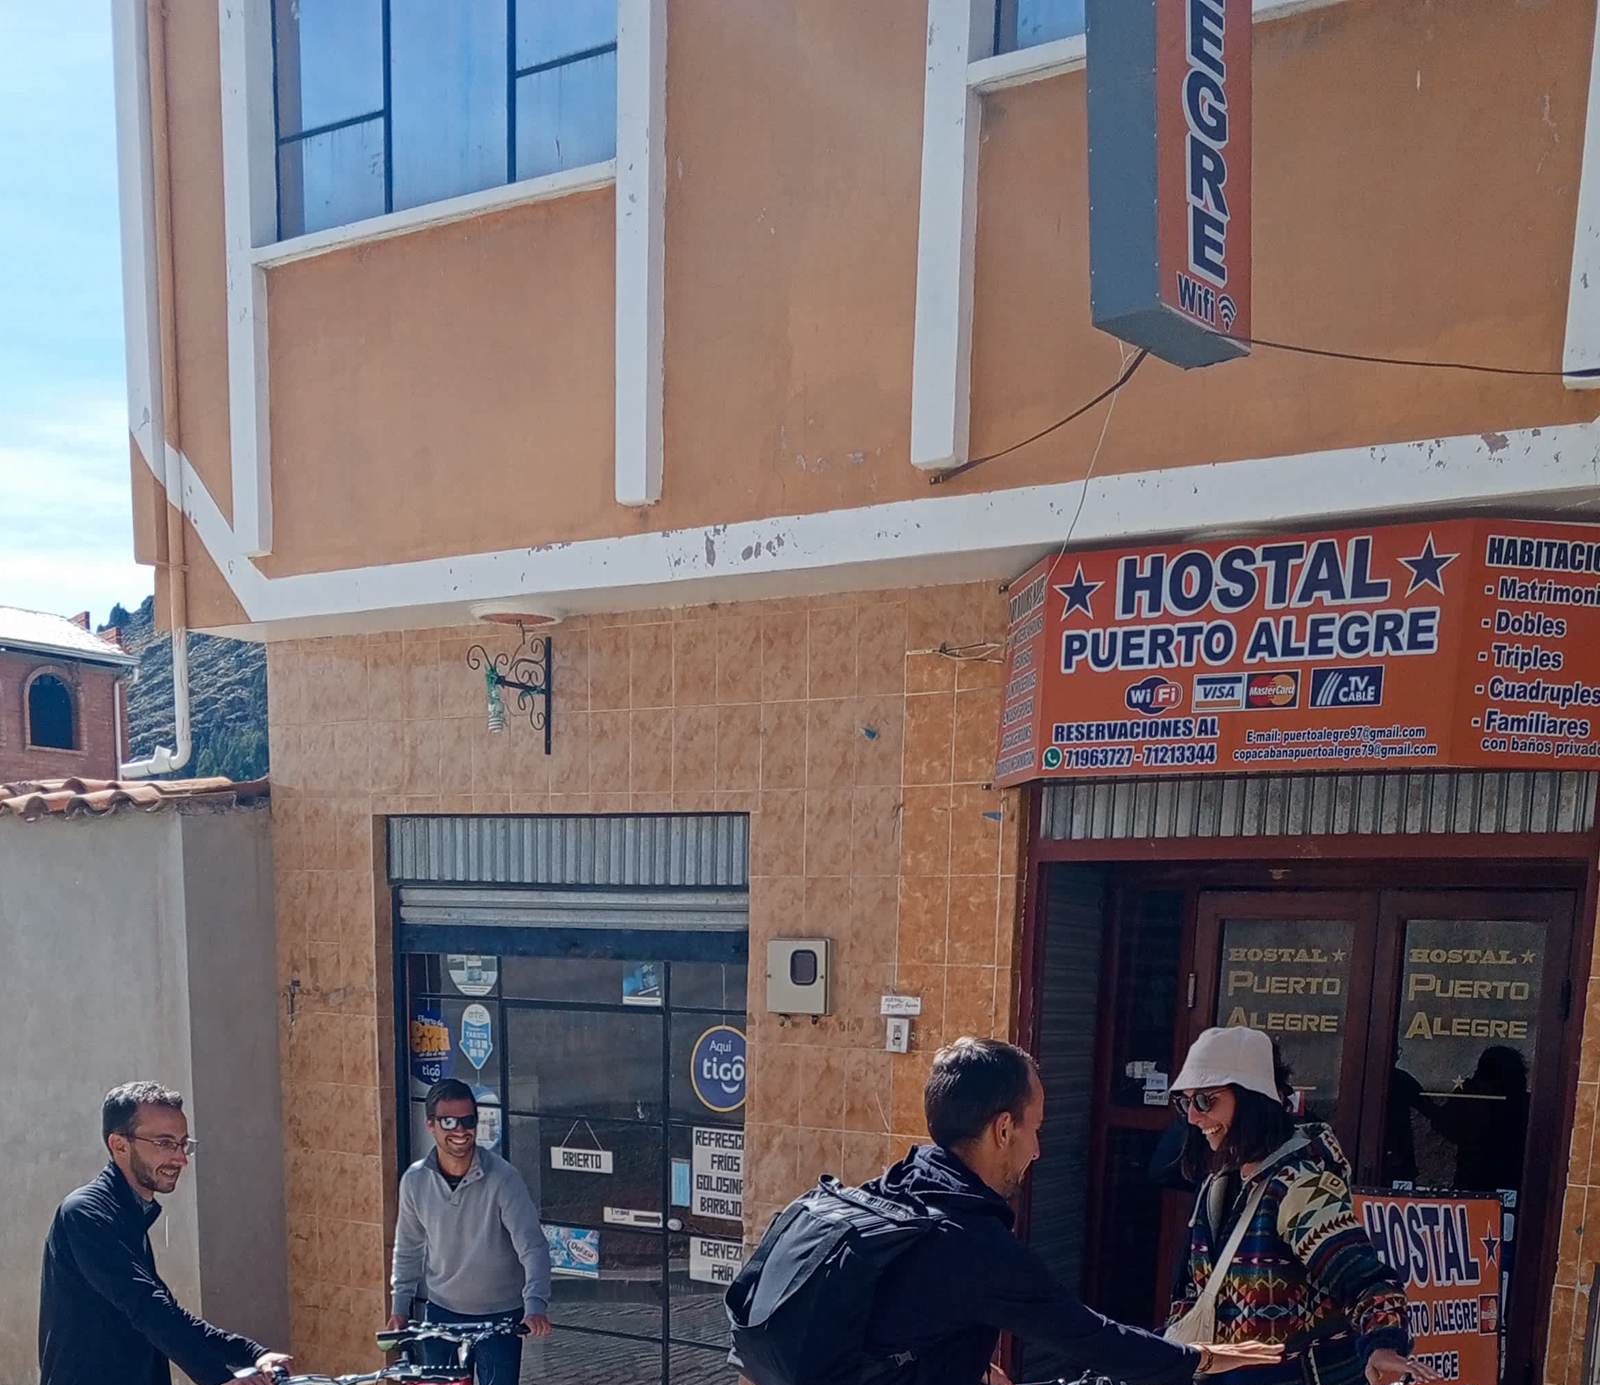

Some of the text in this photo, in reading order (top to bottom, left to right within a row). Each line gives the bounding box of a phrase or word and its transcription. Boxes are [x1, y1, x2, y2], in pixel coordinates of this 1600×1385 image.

[1182, 0, 1229, 289] EGRE
[1176, 271, 1216, 326] Wifi
[1116, 536, 1391, 620] HOSTAL
[1494, 609, 1567, 638] Dobles
[1061, 620, 1238, 673] PUERTO
[1243, 607, 1440, 664] ALEGRE
[1492, 643, 1563, 673] Triples
[1202, 686, 1235, 700] VISA
[1338, 685, 1375, 702] CABLE
[1348, 675, 1370, 691] TV
[1489, 675, 1600, 709] Cuadruples
[1053, 718, 1194, 744] RESERVACIONES
[1196, 716, 1219, 738] AL
[1484, 709, 1590, 738] Familiares
[1246, 729, 1281, 744] E-mail:
[1481, 738, 1507, 751] con
[1510, 736, 1552, 753] baños
[1065, 746, 1134, 769] 71963727
[1143, 743, 1218, 766] 71213344
[1230, 948, 1327, 963] HOSTAL
[1408, 948, 1517, 965] HOSTAL
[695, 1130, 744, 1150] REFRESC
[562, 1151, 602, 1169] ABIERTO
[711, 1152, 741, 1172] FRÍOS
[700, 1196, 742, 1217] BARBIJO
[1362, 1200, 1480, 1289] HOSTAL
[711, 1261, 733, 1281] FRÍA
[1432, 1298, 1478, 1335] ALEGRE
